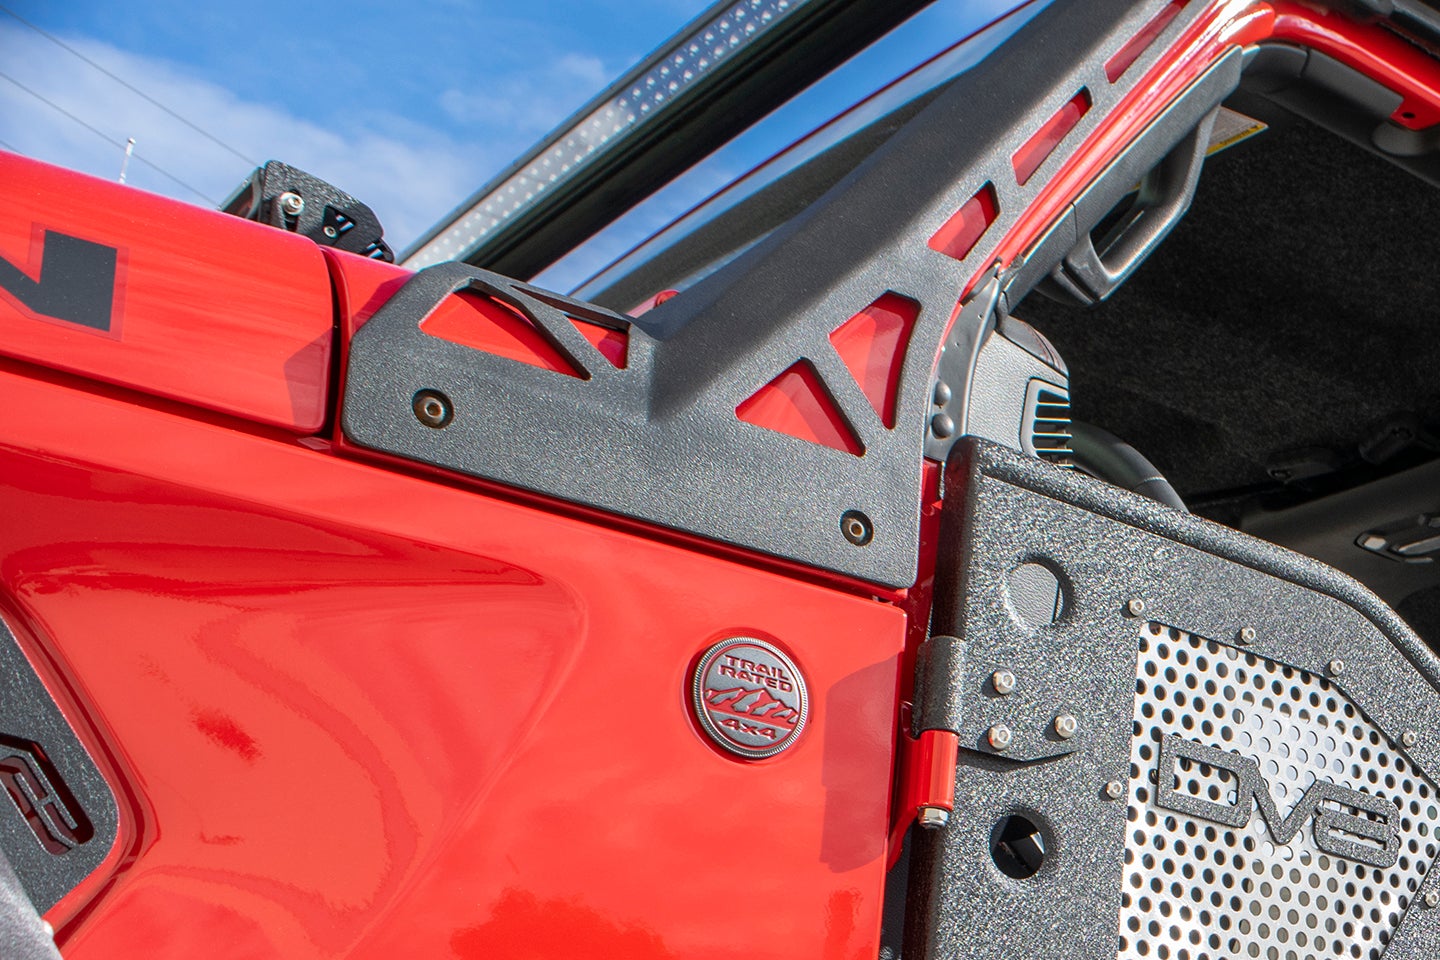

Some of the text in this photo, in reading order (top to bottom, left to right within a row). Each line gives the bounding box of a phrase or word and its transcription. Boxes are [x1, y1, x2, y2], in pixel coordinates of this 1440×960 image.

[718, 665, 793, 692] RATED
[723, 654, 789, 680] TRAIL
[1155, 733, 1400, 869] DV8
